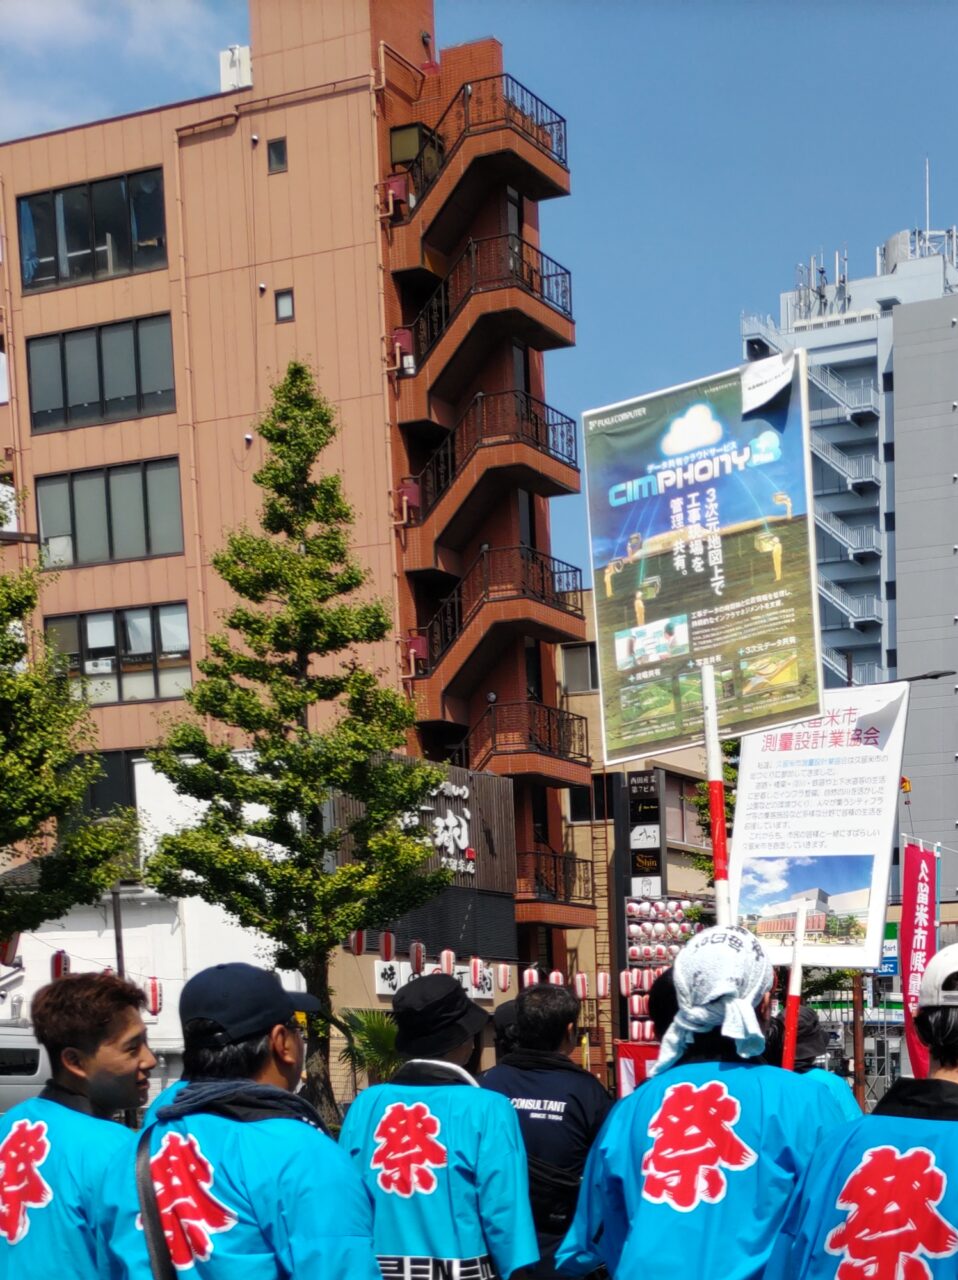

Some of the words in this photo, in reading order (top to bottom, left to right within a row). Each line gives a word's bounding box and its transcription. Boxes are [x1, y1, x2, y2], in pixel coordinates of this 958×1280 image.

[760, 726, 881, 753] 測量設計業協会
[510, 1097, 567, 1113] CONSULTANT
[370, 1101, 449, 1199] 祭
[641, 1080, 759, 1213] 祭
